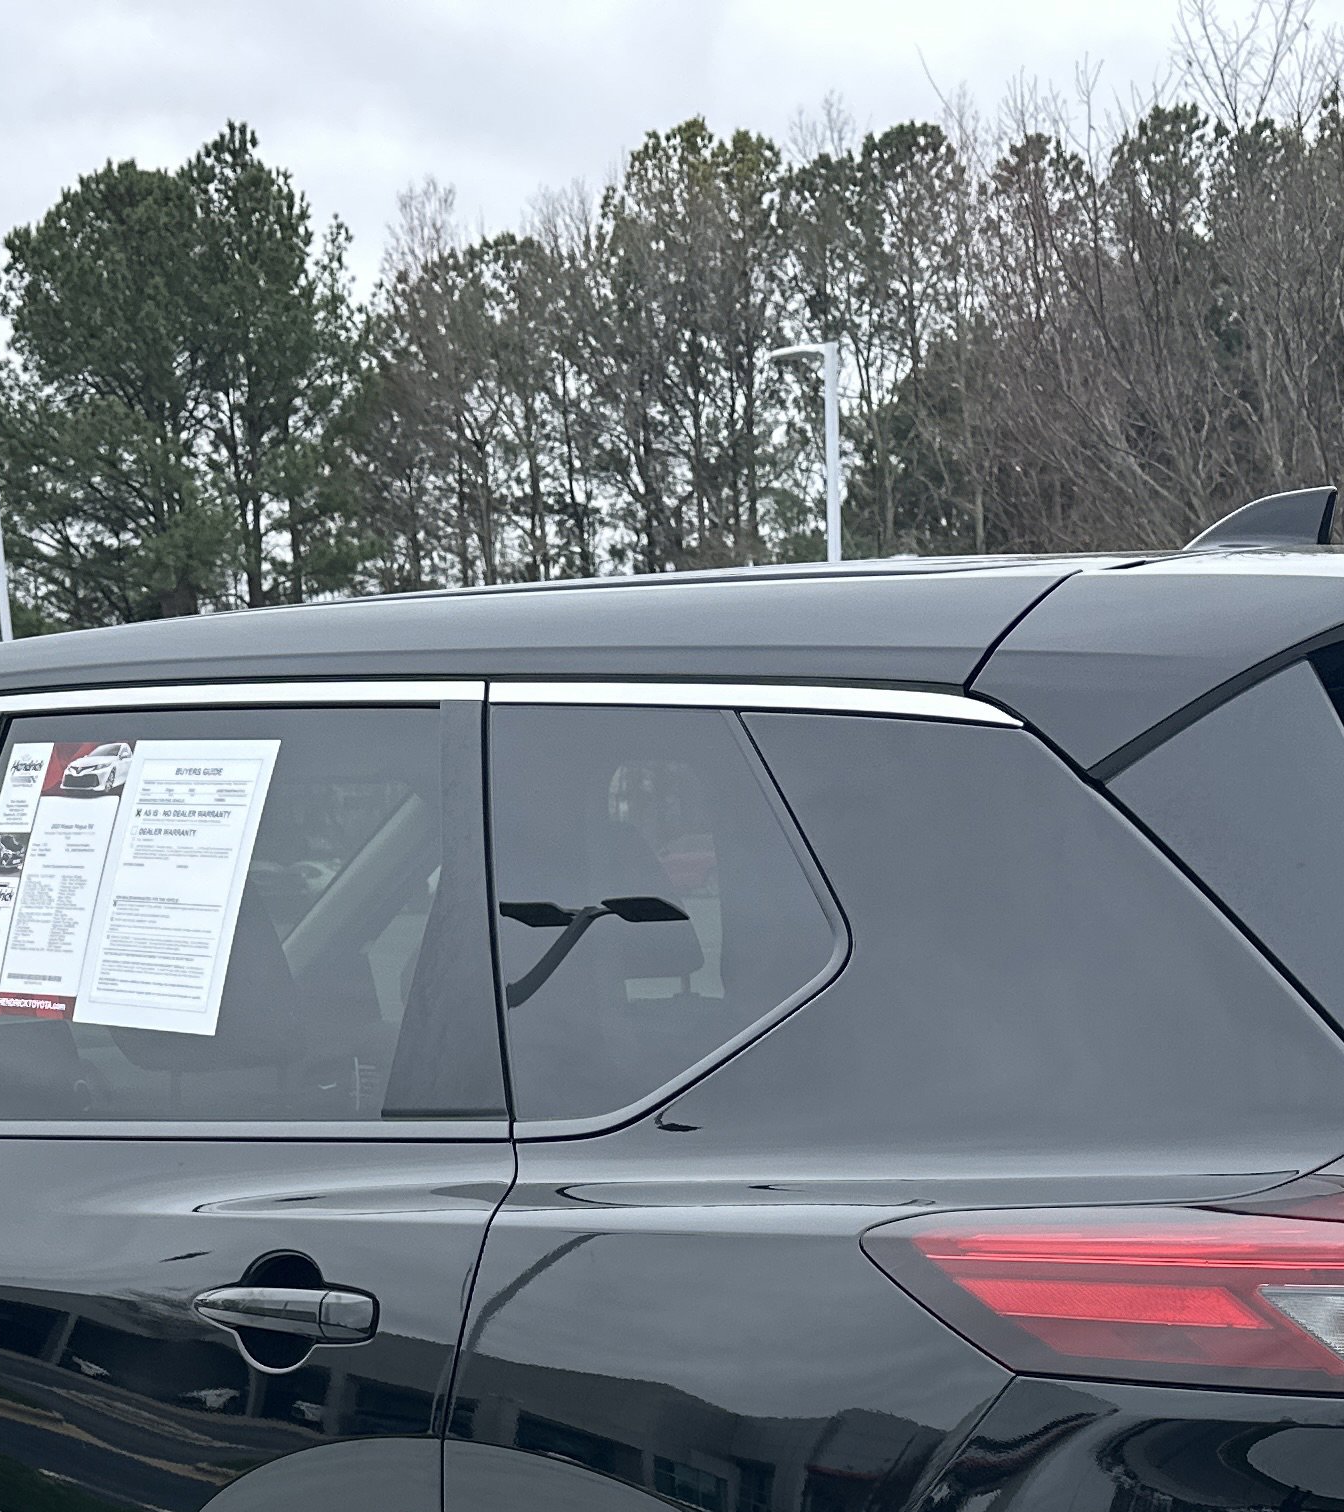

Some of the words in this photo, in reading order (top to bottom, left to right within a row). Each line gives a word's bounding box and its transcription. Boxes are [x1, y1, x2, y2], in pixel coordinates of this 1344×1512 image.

[175, 768, 201, 776] BUYERS
[172, 810, 196, 818] DEALER
[139, 828, 162, 836] DEALER
